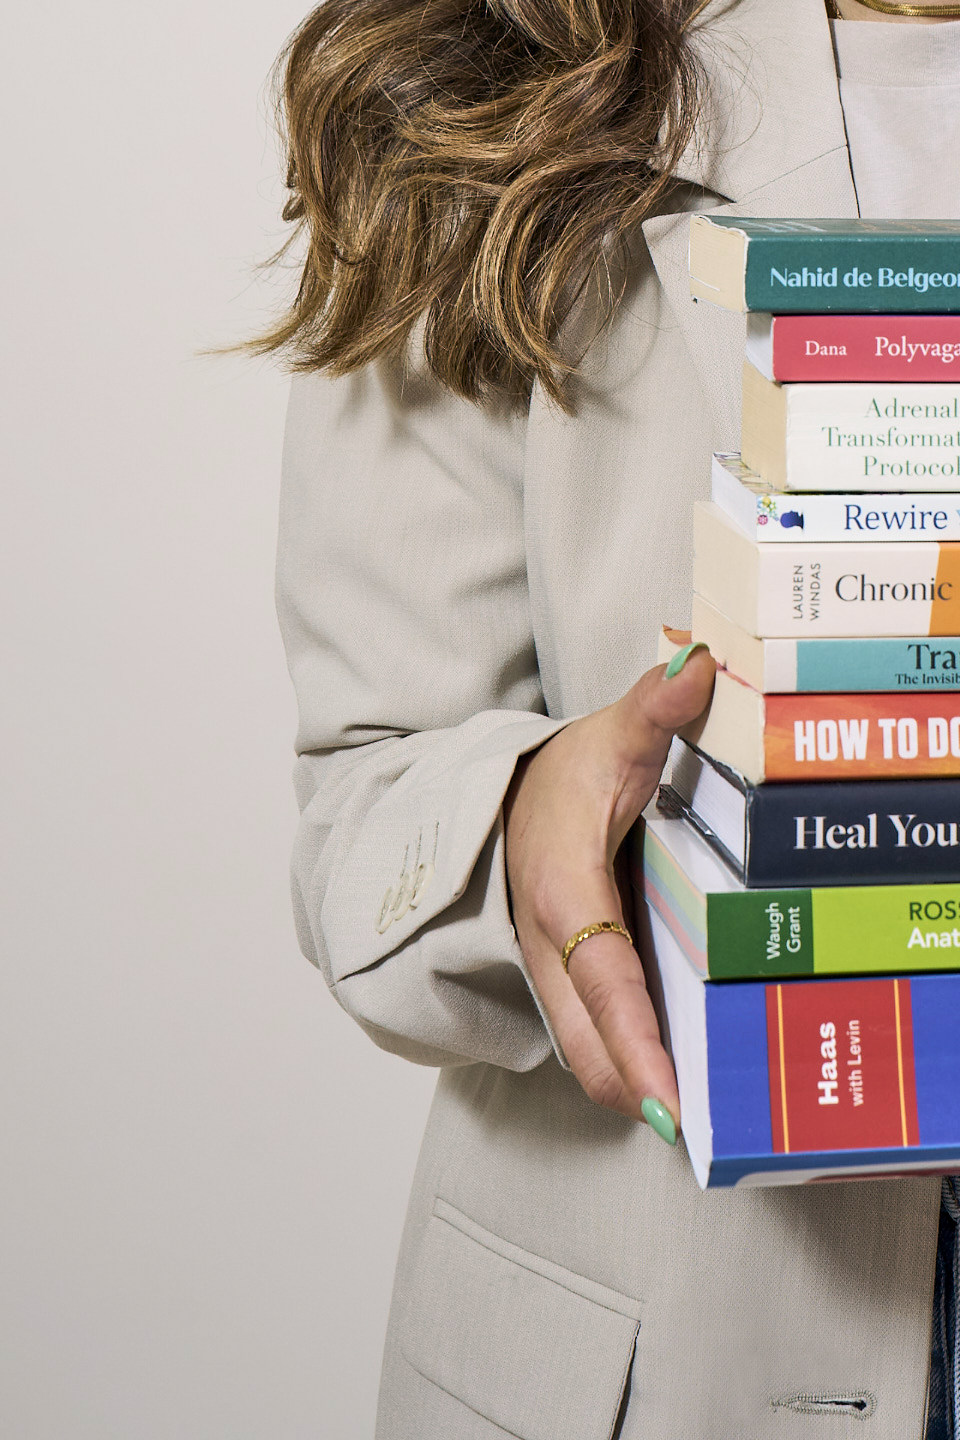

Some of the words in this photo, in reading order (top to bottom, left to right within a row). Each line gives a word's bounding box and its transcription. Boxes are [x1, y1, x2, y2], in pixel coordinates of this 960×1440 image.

[770, 266, 838, 289] Nahid
[843, 267, 873, 288] de
[805, 340, 848, 357] Dana
[864, 397, 959, 420] Adrenal
[844, 504, 949, 532] Rewire
[793, 564, 804, 621] LAUREN
[810, 562, 822, 621] WINDAS
[834, 574, 954, 603] Chronic
[895, 673, 918, 686] The
[794, 719, 869, 762] HOW
[878, 718, 919, 760] TO
[792, 812, 878, 850] Heal
[766, 901, 784, 961] Waugh
[786, 906, 802, 954] Grant
[846, 1018, 862, 1064] Levin
[817, 1021, 840, 1106] Haas
[850, 1068, 864, 1108] with
